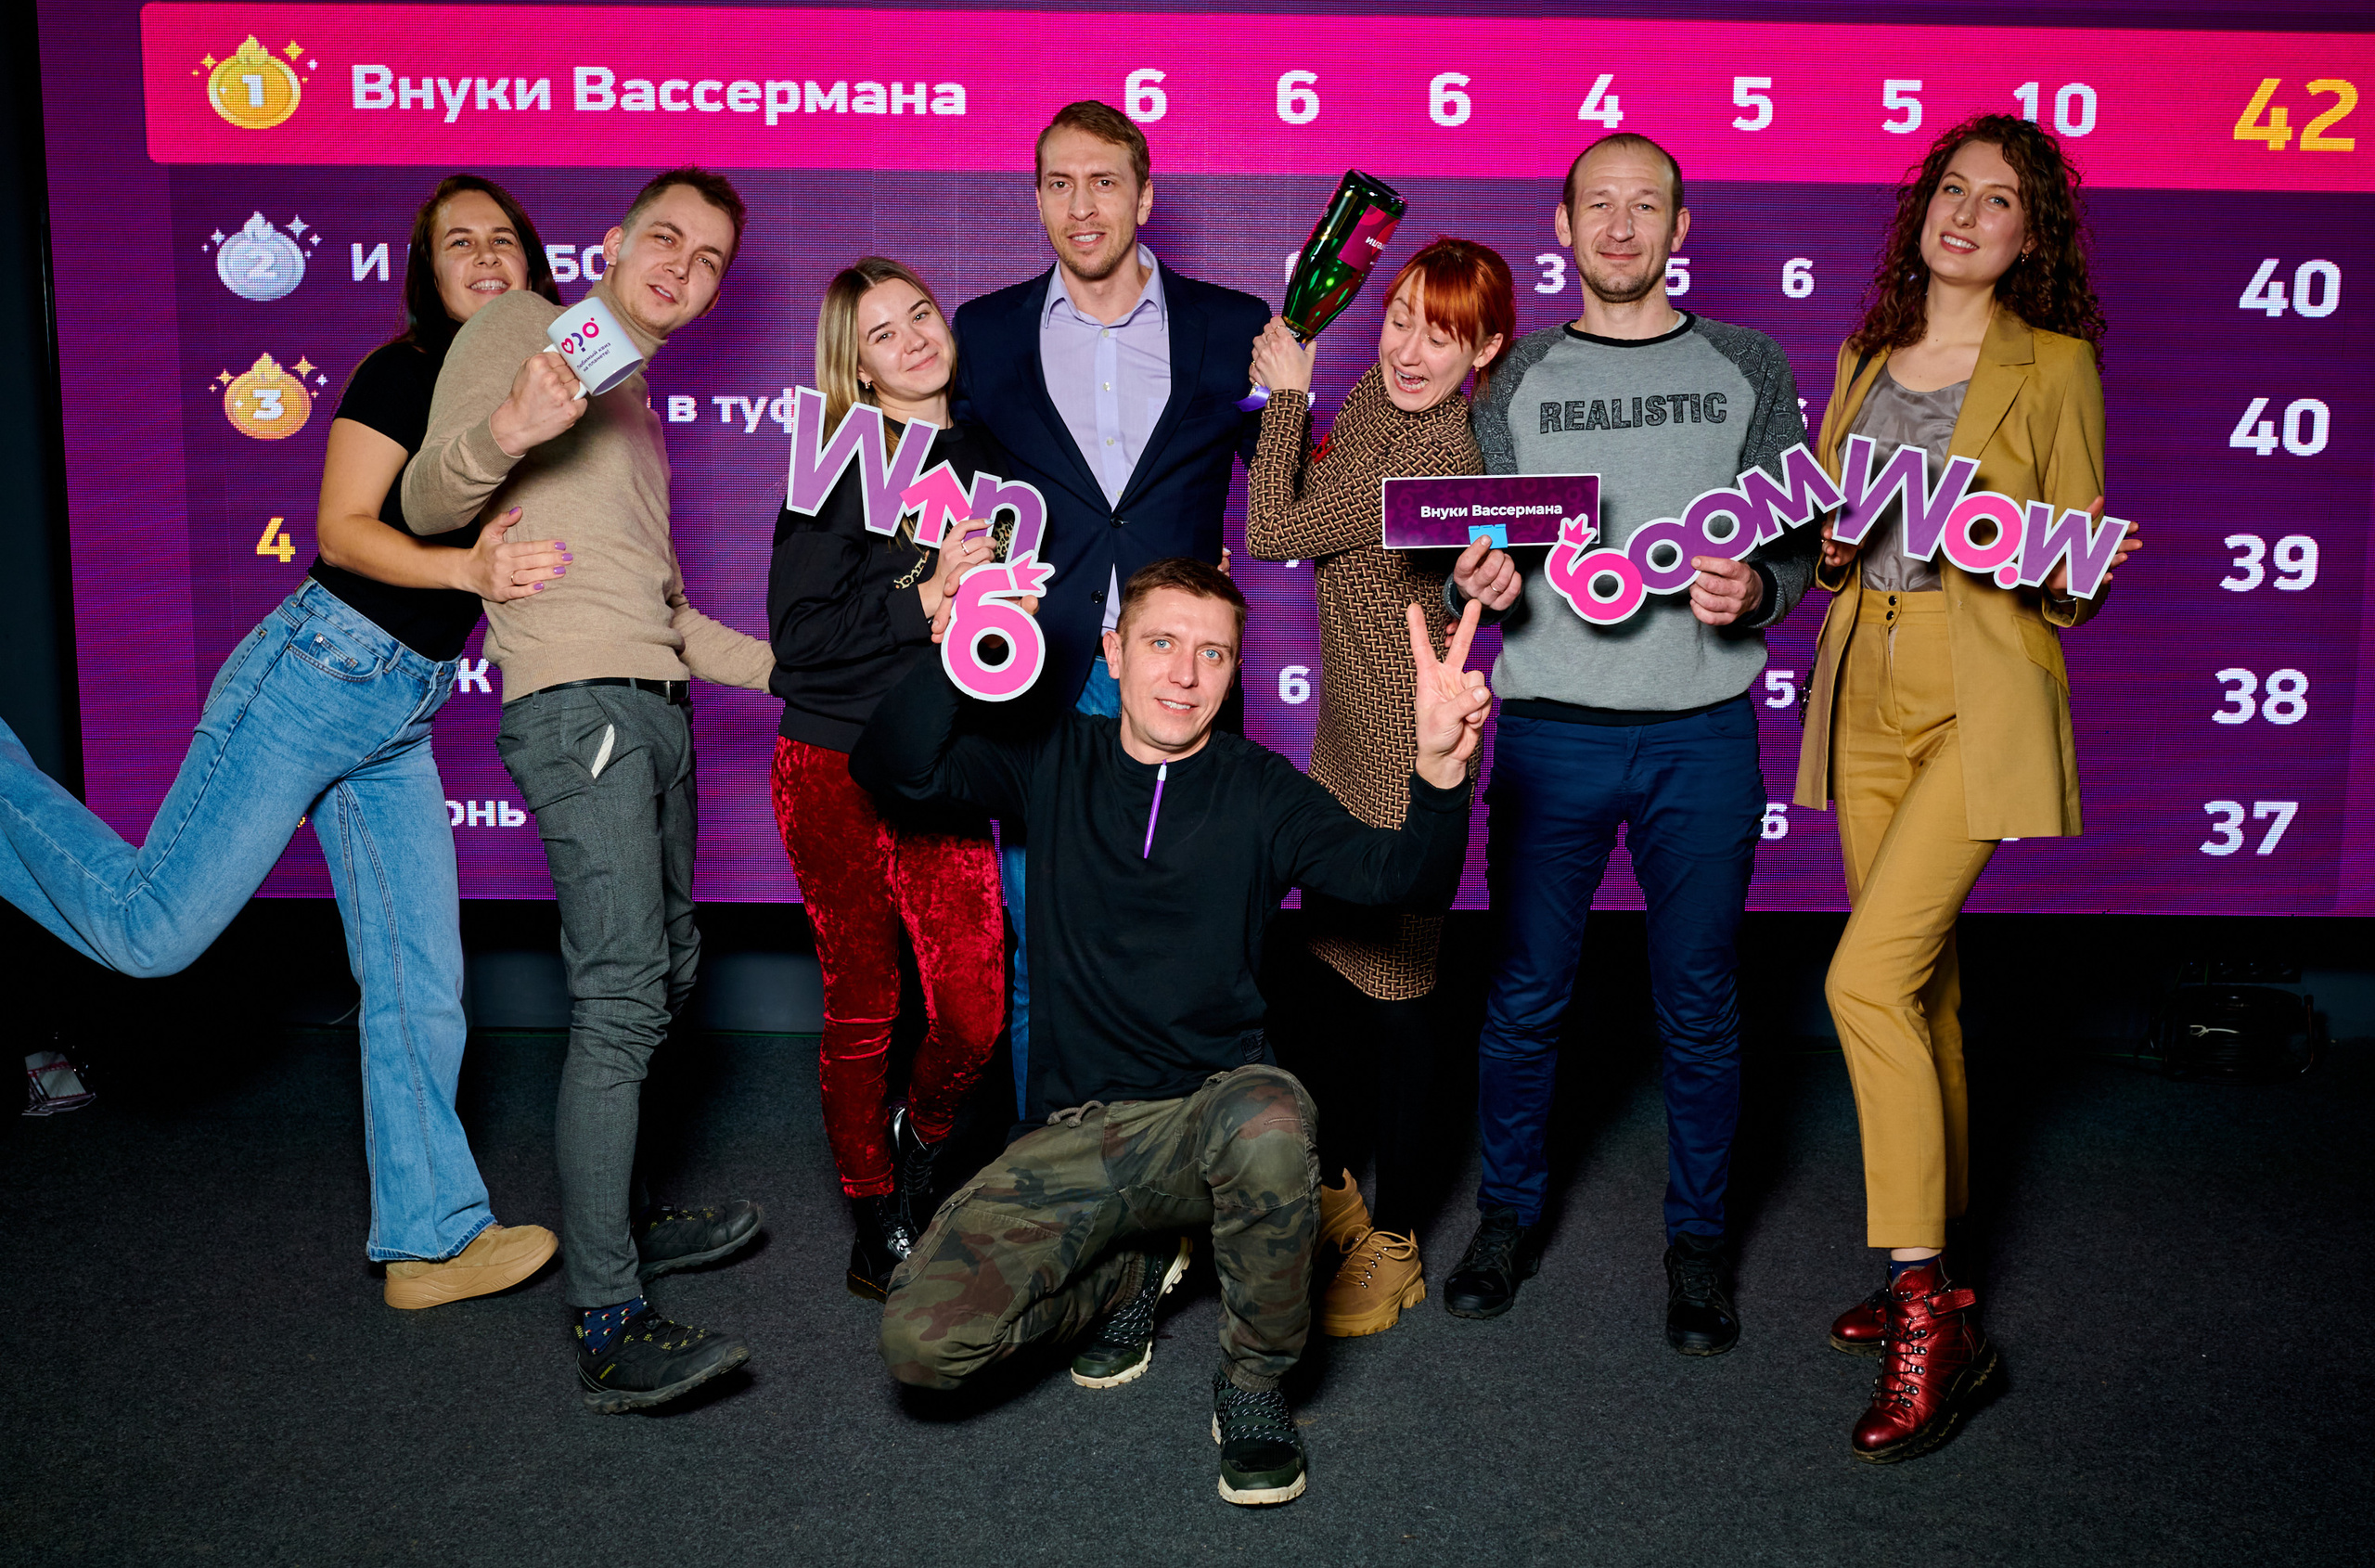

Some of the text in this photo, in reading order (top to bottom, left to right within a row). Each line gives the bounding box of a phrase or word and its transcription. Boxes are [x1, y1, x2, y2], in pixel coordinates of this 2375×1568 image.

[242, 64, 2358, 151] 1 Внуки Вассермана 6 6 6 4 5 5 10 42
[247, 251, 276, 278] 2
[351, 243, 391, 281] И
[1534, 253, 1566, 294] 3
[1781, 257, 1815, 298] 6
[2239, 259, 2342, 317] 40
[252, 390, 284, 420] 3
[667, 395, 698, 422] в
[2228, 398, 2330, 456] 40
[1540, 392, 1727, 433] REALISTIC
[1420, 505, 1563, 520] Внуки Вассермана
[256, 518, 2319, 592] 4 39
[1278, 665, 1311, 704] 6
[1765, 671, 1795, 708] 5
[2211, 668, 2309, 725] 38
[1761, 803, 1789, 839] 6
[2199, 801, 2299, 855] 37
